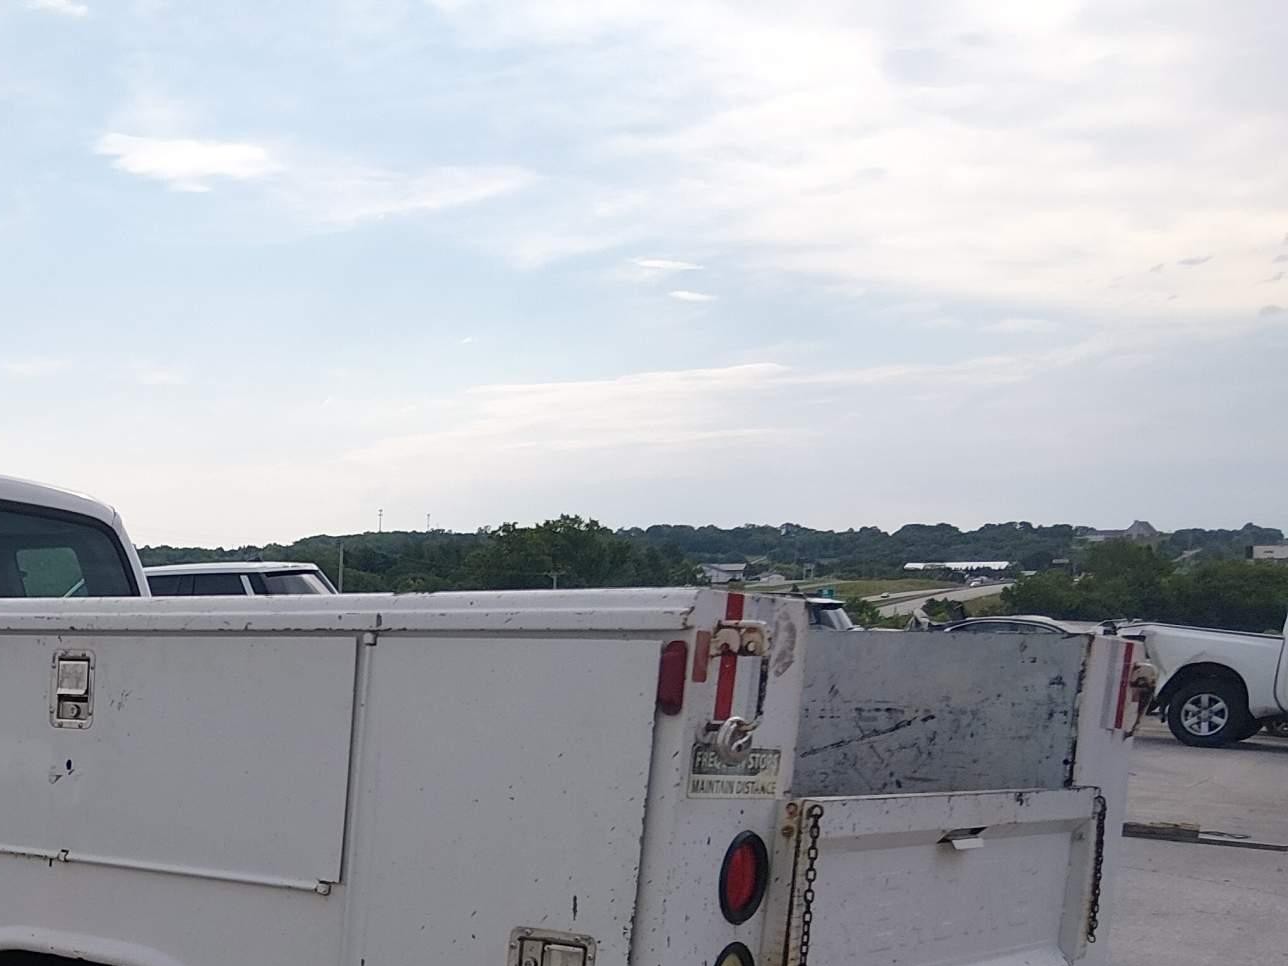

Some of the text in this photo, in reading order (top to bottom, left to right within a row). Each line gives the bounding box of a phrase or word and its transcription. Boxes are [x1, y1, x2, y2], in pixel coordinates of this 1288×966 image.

[747, 752, 780, 770] STOPS
[691, 779, 777, 795] MAINTAIN DISTANCE
